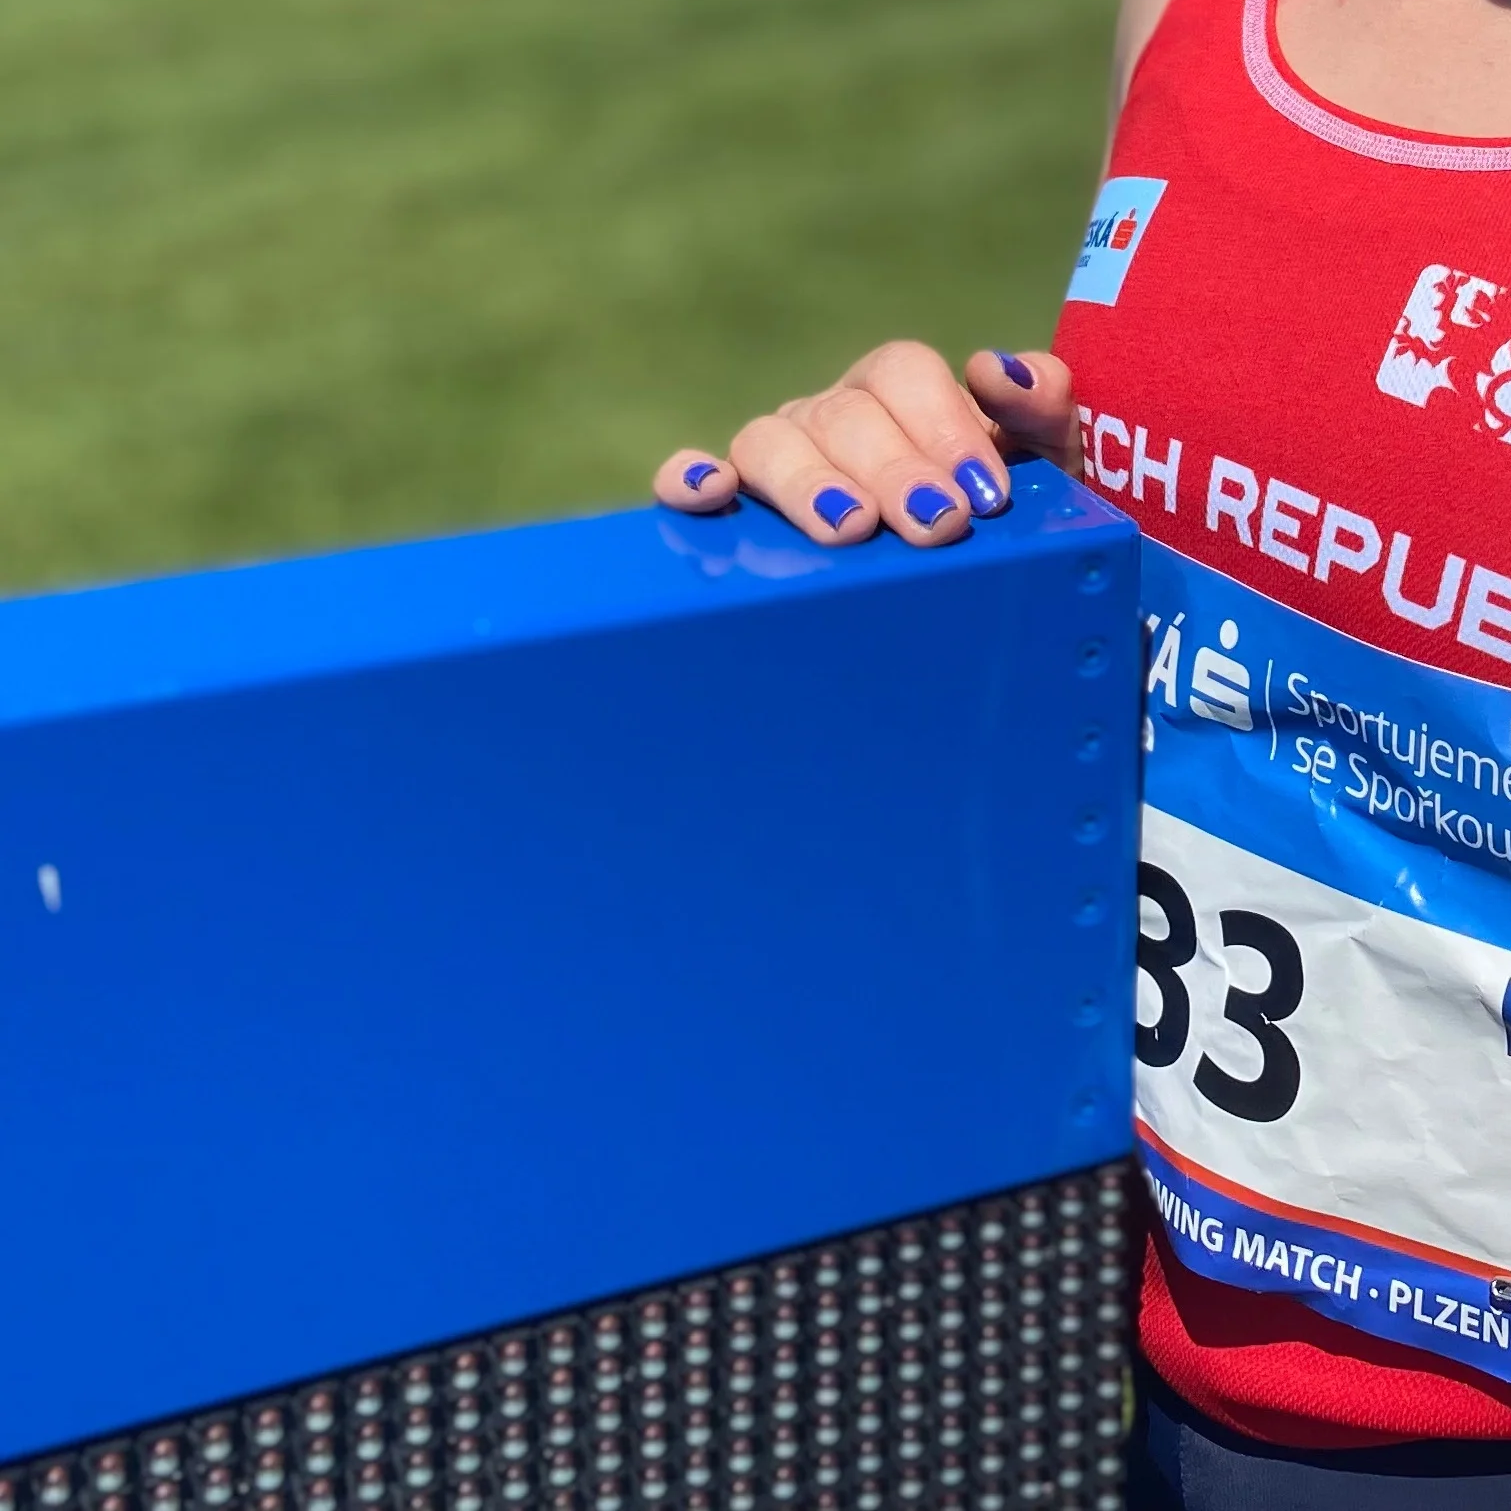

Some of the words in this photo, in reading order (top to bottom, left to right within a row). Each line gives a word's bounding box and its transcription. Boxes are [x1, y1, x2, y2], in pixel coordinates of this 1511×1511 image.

[1147, 611, 1186, 708] Á
[1292, 736, 1337, 784] se
[1145, 1170, 1224, 1254] WING
[1232, 1227, 1363, 1301] MATCH
[1388, 1278, 1510, 1350] PLZEŇ
